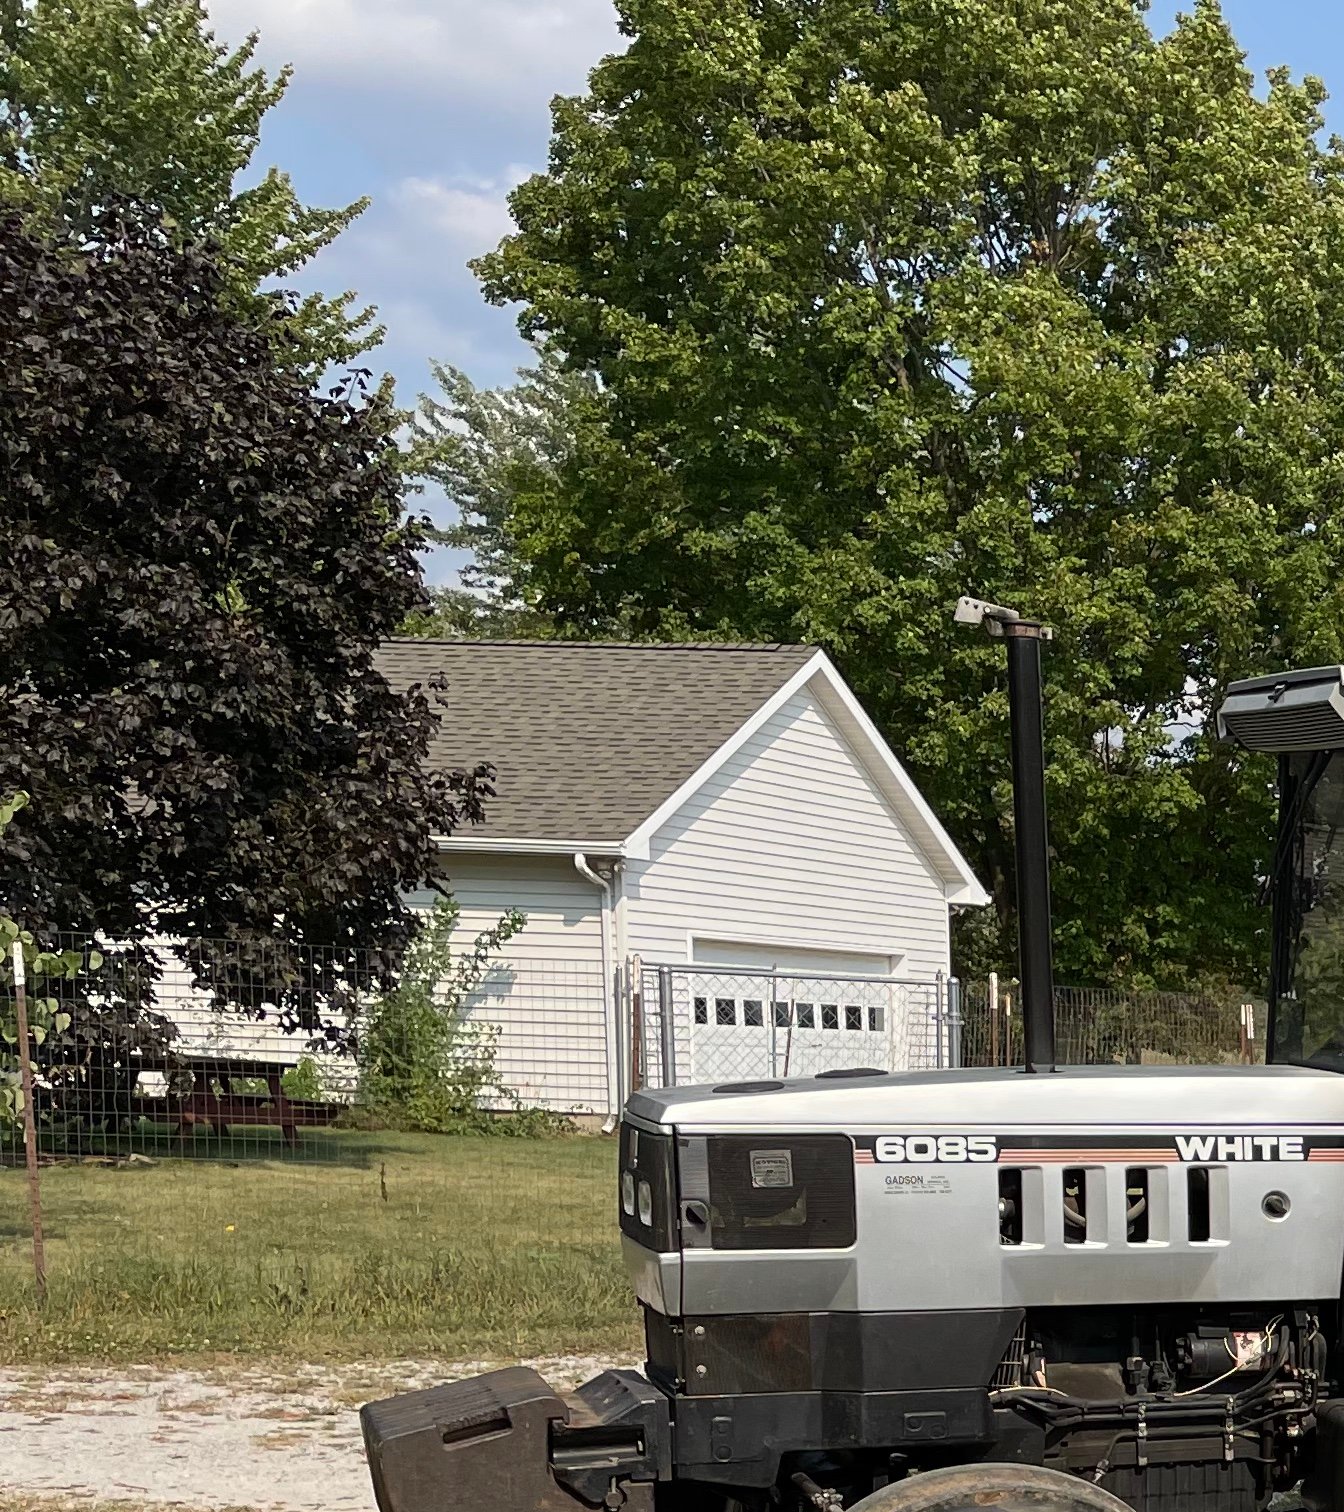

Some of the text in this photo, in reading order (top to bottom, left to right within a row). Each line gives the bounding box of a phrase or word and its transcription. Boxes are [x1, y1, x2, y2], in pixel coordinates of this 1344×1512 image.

[876, 1136, 996, 1161] 6085
[1175, 1136, 1304, 1160] WHITE
[885, 1175, 924, 1185] GADSON
